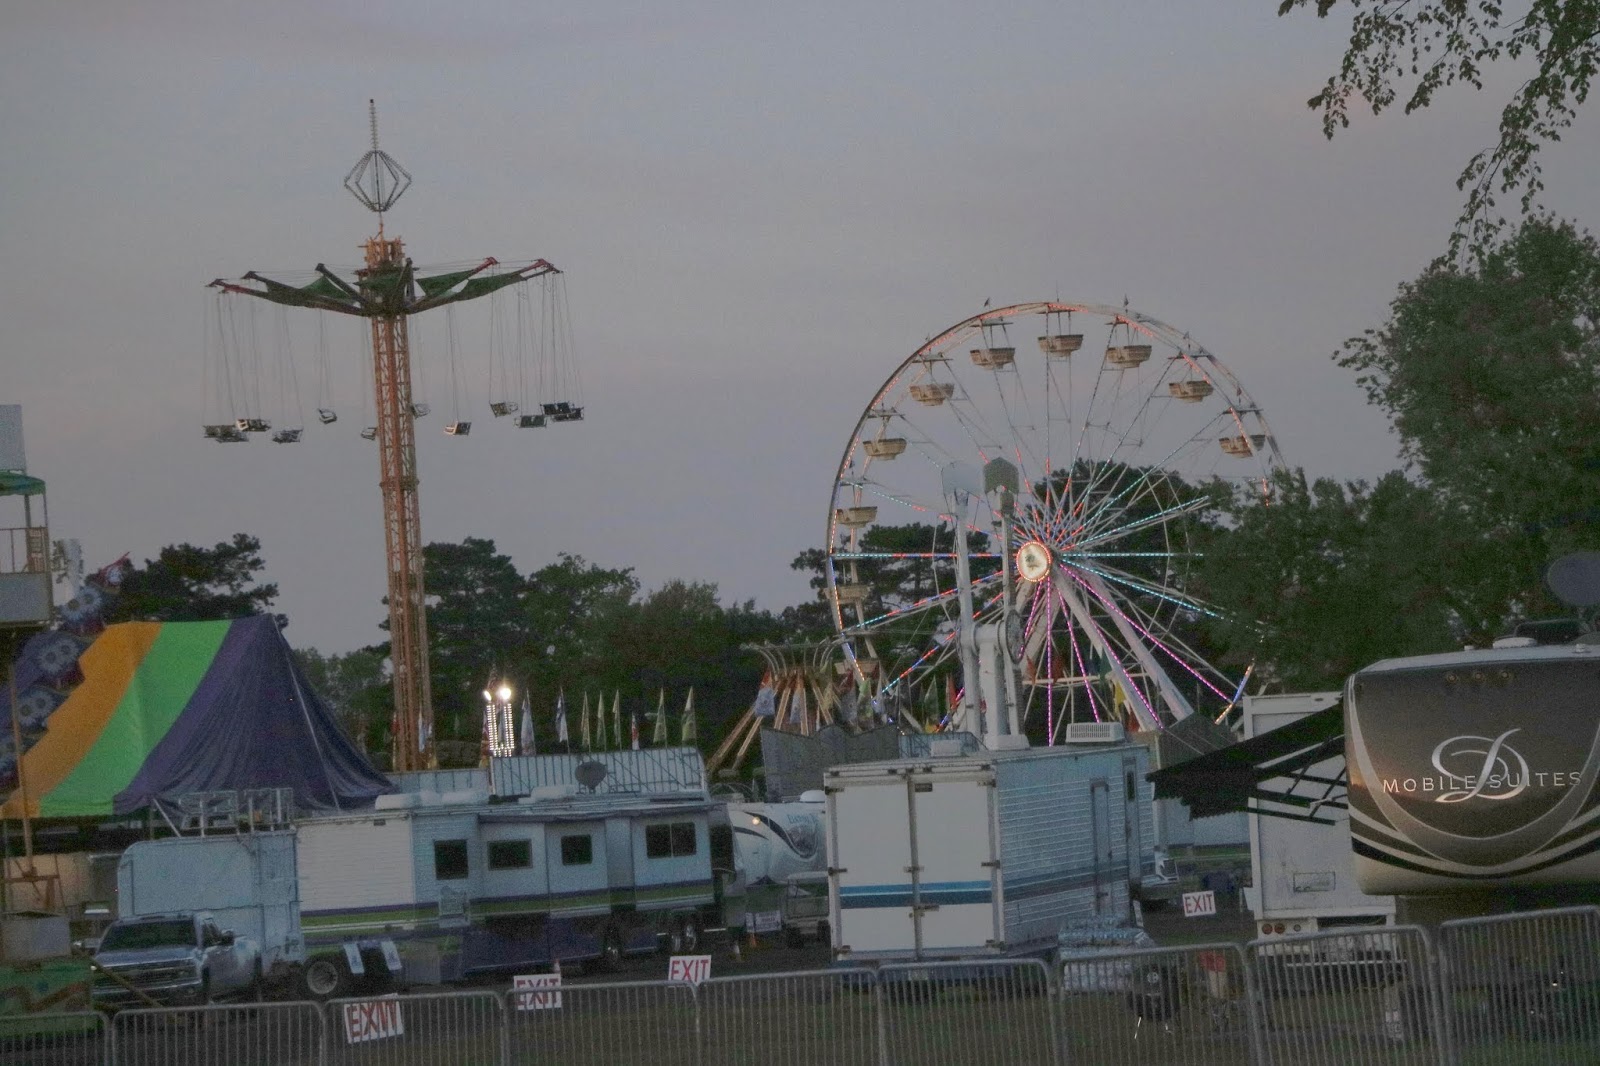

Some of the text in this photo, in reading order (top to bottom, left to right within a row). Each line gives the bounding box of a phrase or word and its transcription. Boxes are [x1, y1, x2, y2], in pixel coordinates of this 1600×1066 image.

[1383, 771, 1583, 793] MOBILE SUITES
[1184, 893, 1212, 914] EXIT
[671, 959, 708, 983] EXIT
[516, 978, 559, 1006] EXIT
[347, 999, 397, 1037] EXIT
